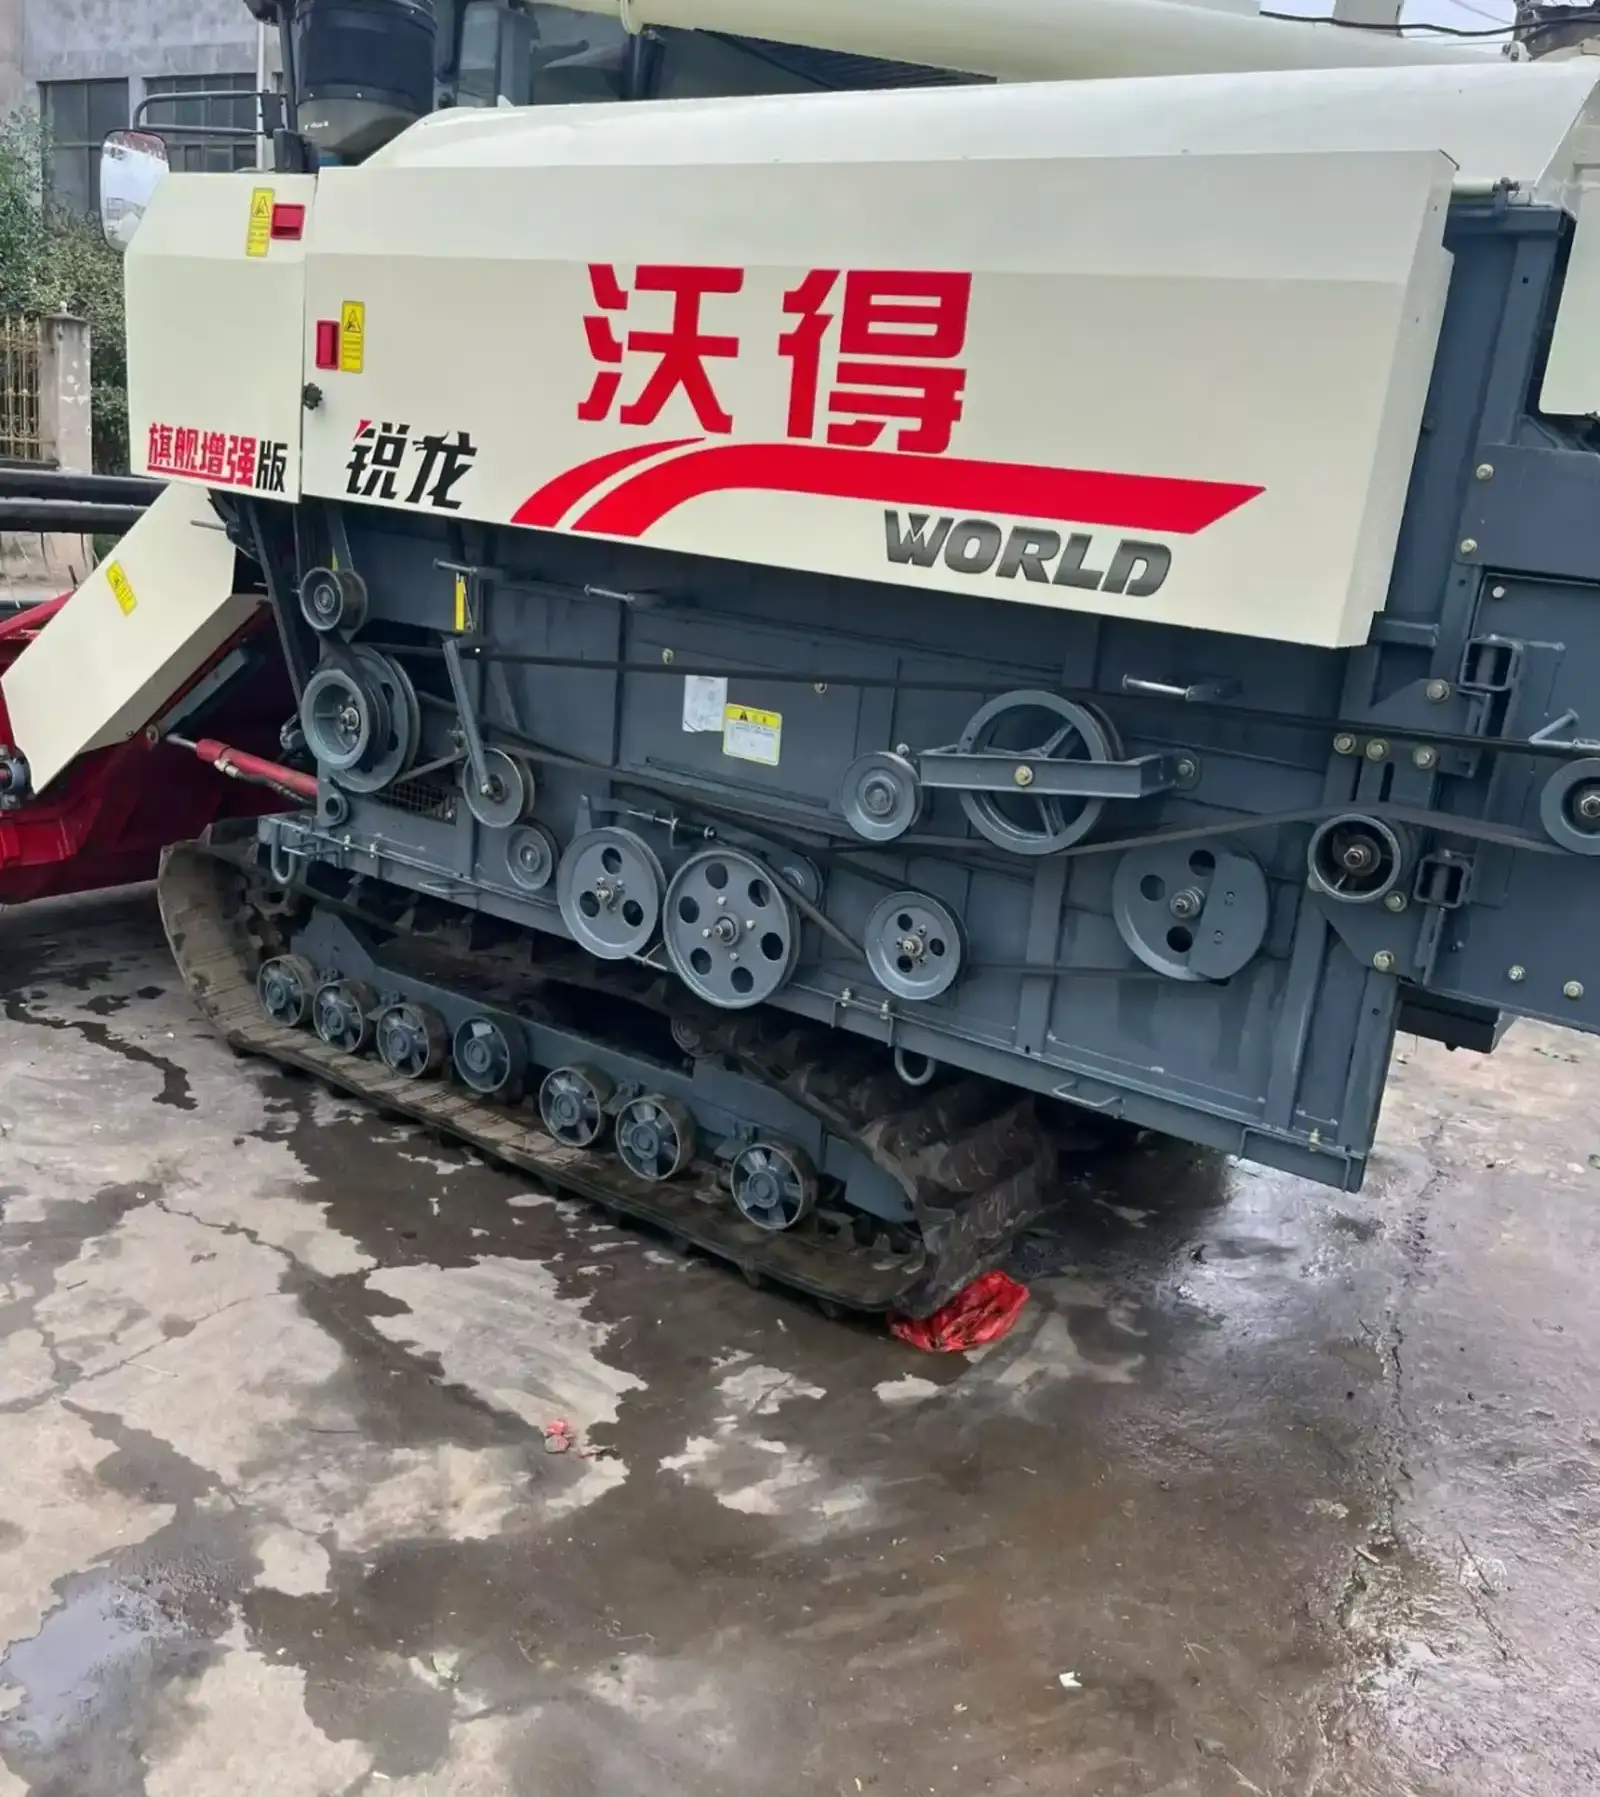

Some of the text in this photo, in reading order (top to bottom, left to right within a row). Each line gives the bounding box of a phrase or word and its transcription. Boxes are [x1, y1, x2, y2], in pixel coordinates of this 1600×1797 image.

[577, 263, 973, 454] 沃得
[147, 422, 289, 493] 旗舰增强版
[345, 419, 478, 510] 锐龙
[884, 509, 1172, 597] WORLD
